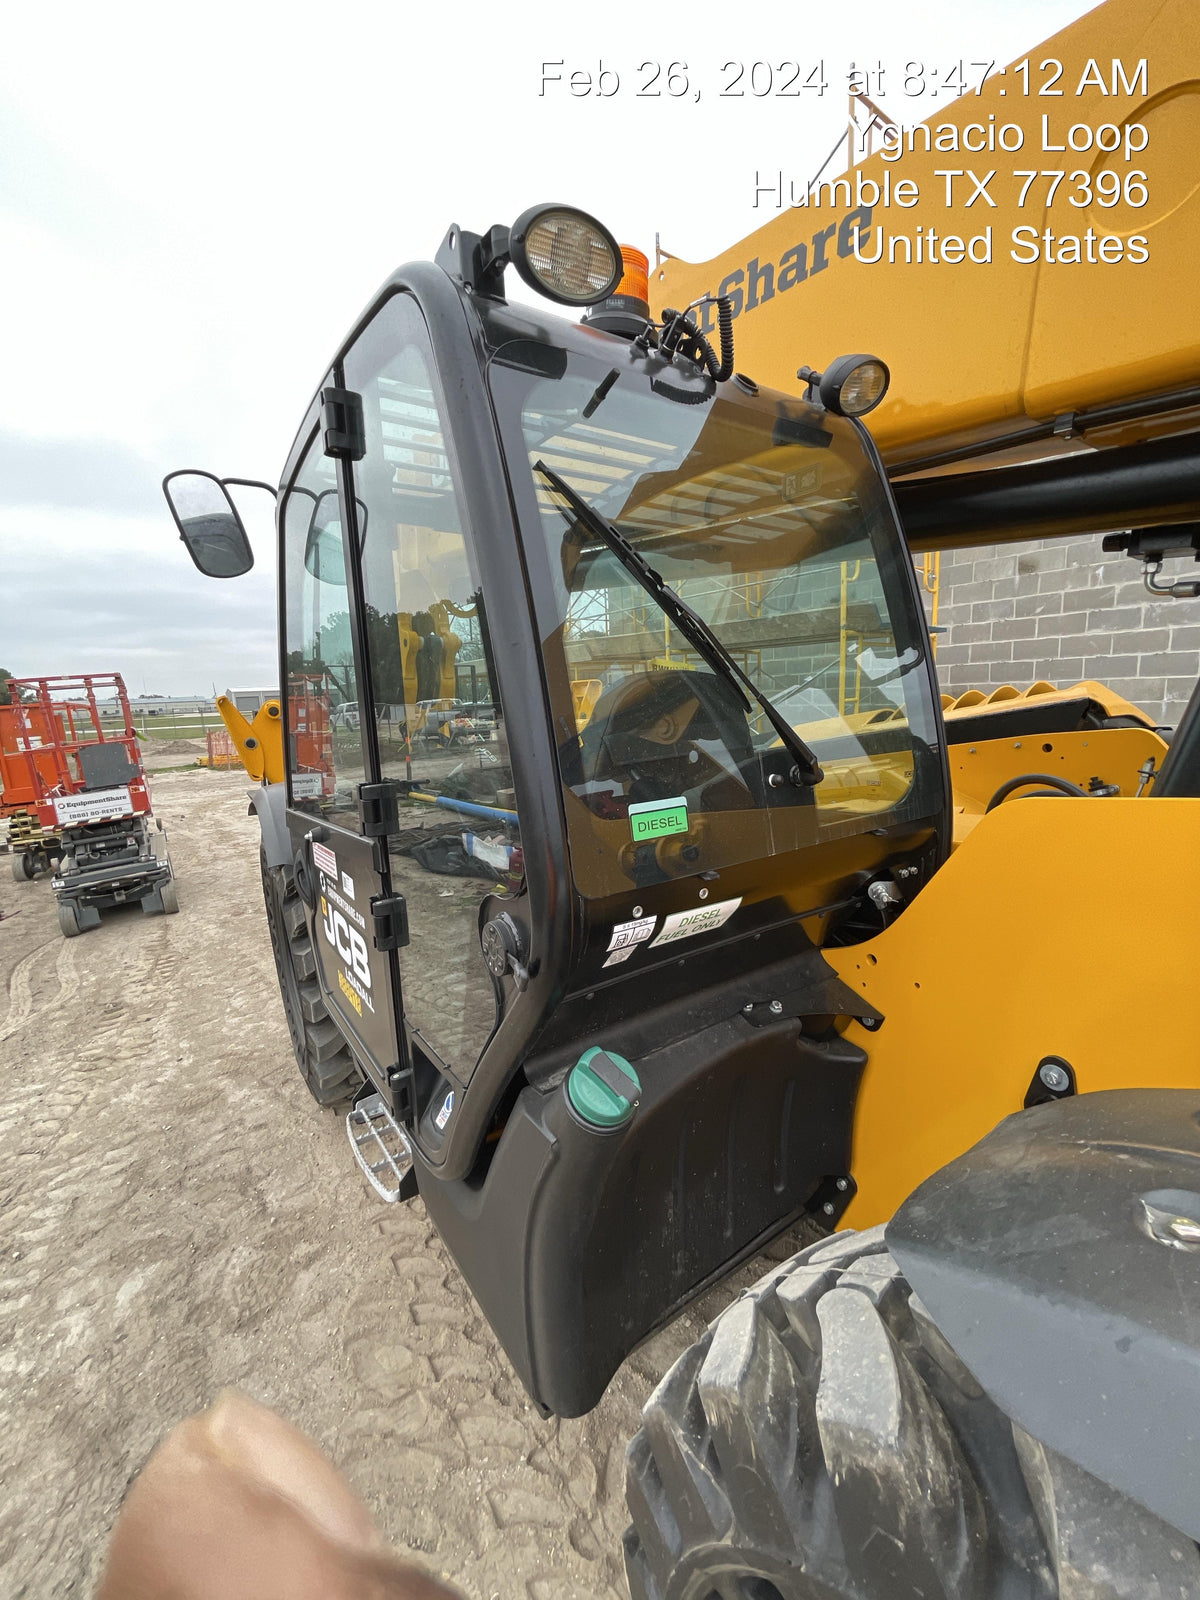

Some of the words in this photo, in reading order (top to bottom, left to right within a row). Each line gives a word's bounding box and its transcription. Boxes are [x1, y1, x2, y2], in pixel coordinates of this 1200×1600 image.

[66, 795, 127, 808] EquipmentShare
[637, 816, 683, 833] DIESEL
[678, 908, 722, 928] DIESEL
[655, 930, 688, 944] FUEL
[691, 919, 725, 933] ONLY
[323, 902, 372, 989] JCB
